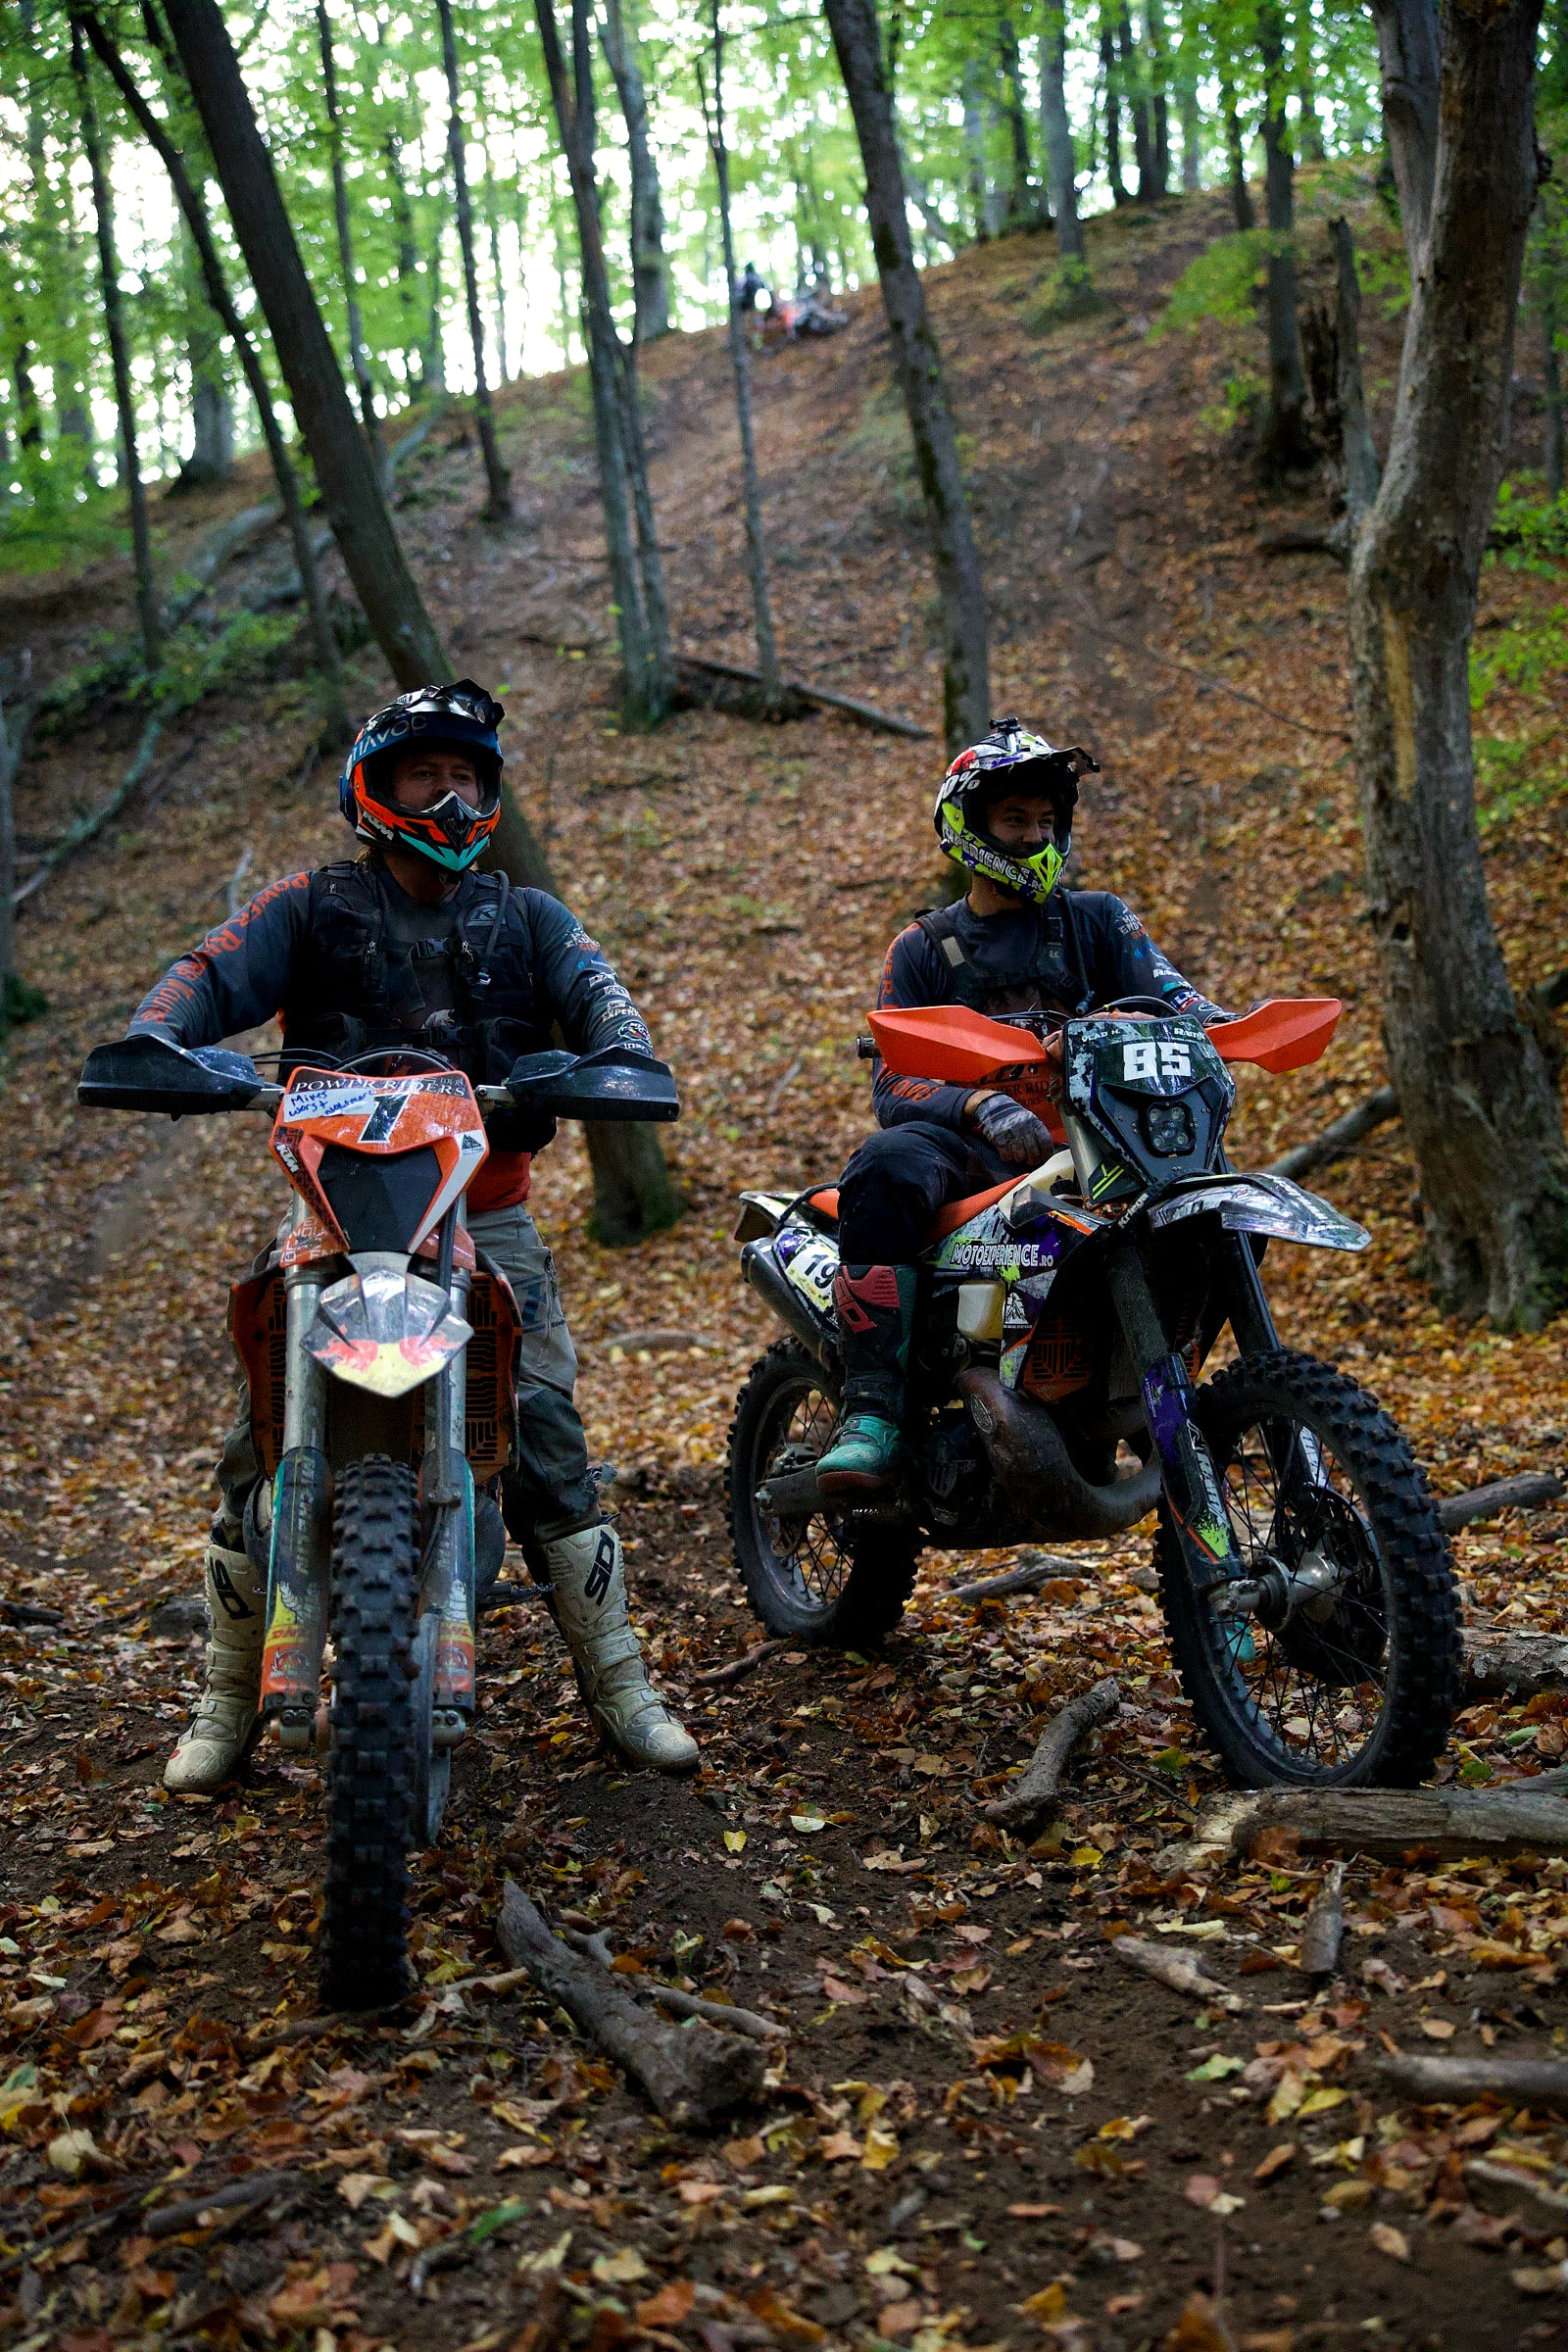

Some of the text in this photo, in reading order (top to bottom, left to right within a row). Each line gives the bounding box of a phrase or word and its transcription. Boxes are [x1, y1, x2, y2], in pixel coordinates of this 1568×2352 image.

[363, 809, 395, 841] KTM
[1123, 1042, 1192, 1082] 85
[295, 1077, 466, 1097] POWER RIDERS
[275, 1143, 300, 1174] KTM
[1117, 1193, 1151, 1229] Kriega
[951, 1243, 1054, 1268] MOTOEXPERIENCE.RO
